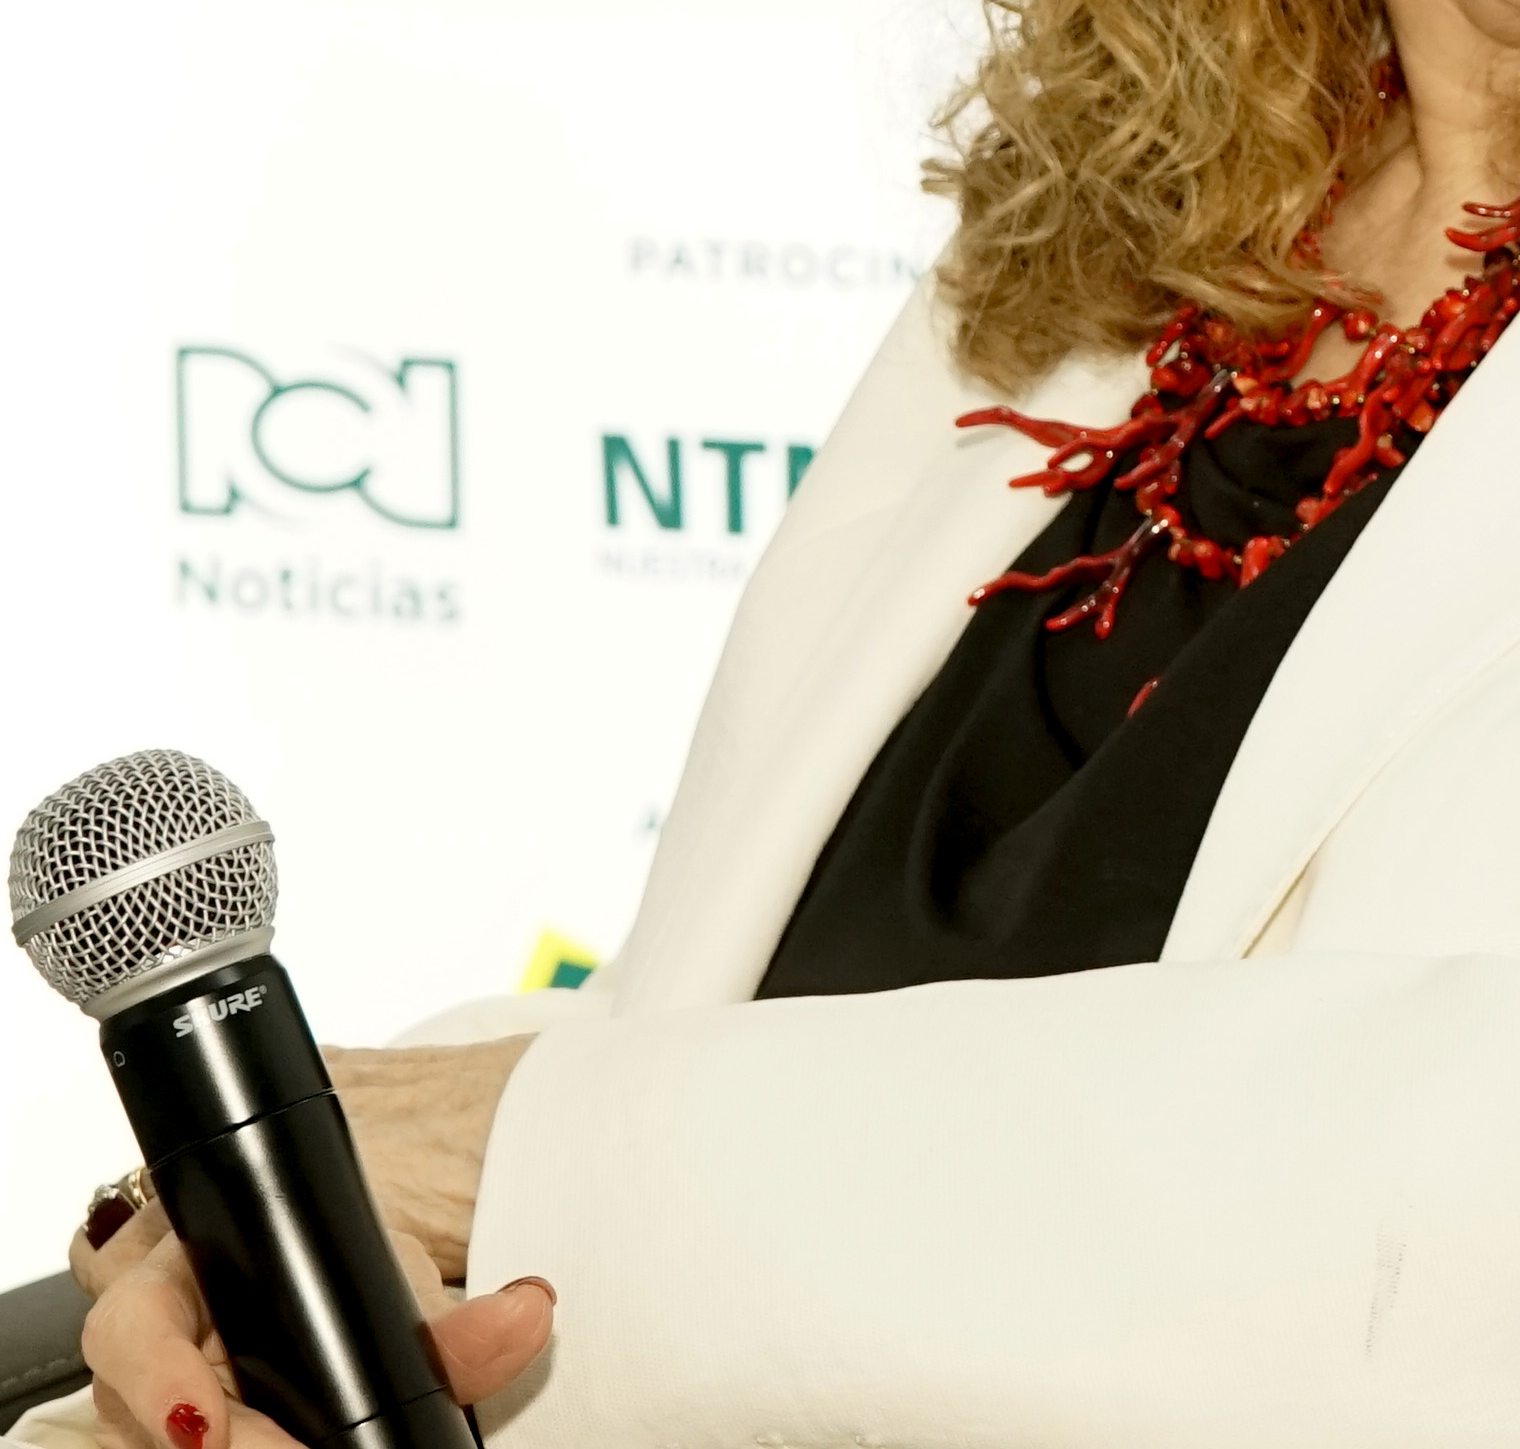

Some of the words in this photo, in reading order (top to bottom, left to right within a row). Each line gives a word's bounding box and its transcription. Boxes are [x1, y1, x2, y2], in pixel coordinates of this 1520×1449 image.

[626, 237, 921, 286] PATROCIN
[174, 555, 461, 625] Noticias
[172, 985, 263, 1038] SURE
